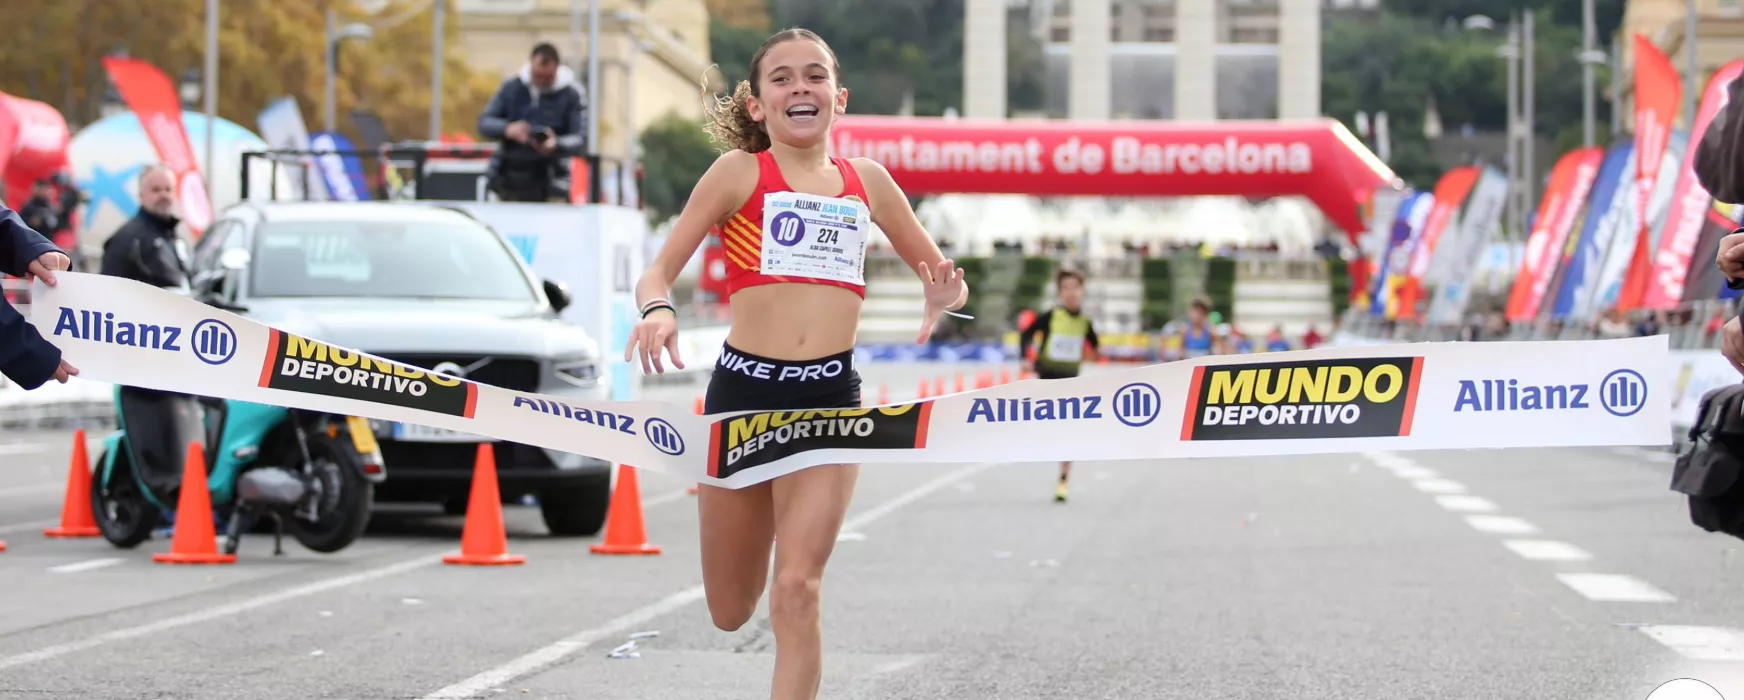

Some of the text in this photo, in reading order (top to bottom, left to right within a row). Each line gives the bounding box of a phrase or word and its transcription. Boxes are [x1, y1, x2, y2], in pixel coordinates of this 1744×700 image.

[822, 131, 1312, 175] juntament de Barcelona
[794, 200, 821, 212] ALLIANZ
[821, 203, 838, 213] JEAN
[777, 217, 799, 241] 10
[817, 228, 838, 244] 274
[53, 306, 182, 351] Allianz
[281, 357, 427, 397] DEPORTIVO
[719, 347, 776, 379] NIKE
[778, 360, 843, 381] PRO
[1206, 363, 1403, 404] MUNDO
[1453, 378, 1589, 412] Allianz
[513, 396, 636, 435] Allianz
[966, 395, 1102, 423] Allianz
[1202, 404, 1361, 426] DEPORTIVO
[727, 417, 874, 466] DEPORTIVO
